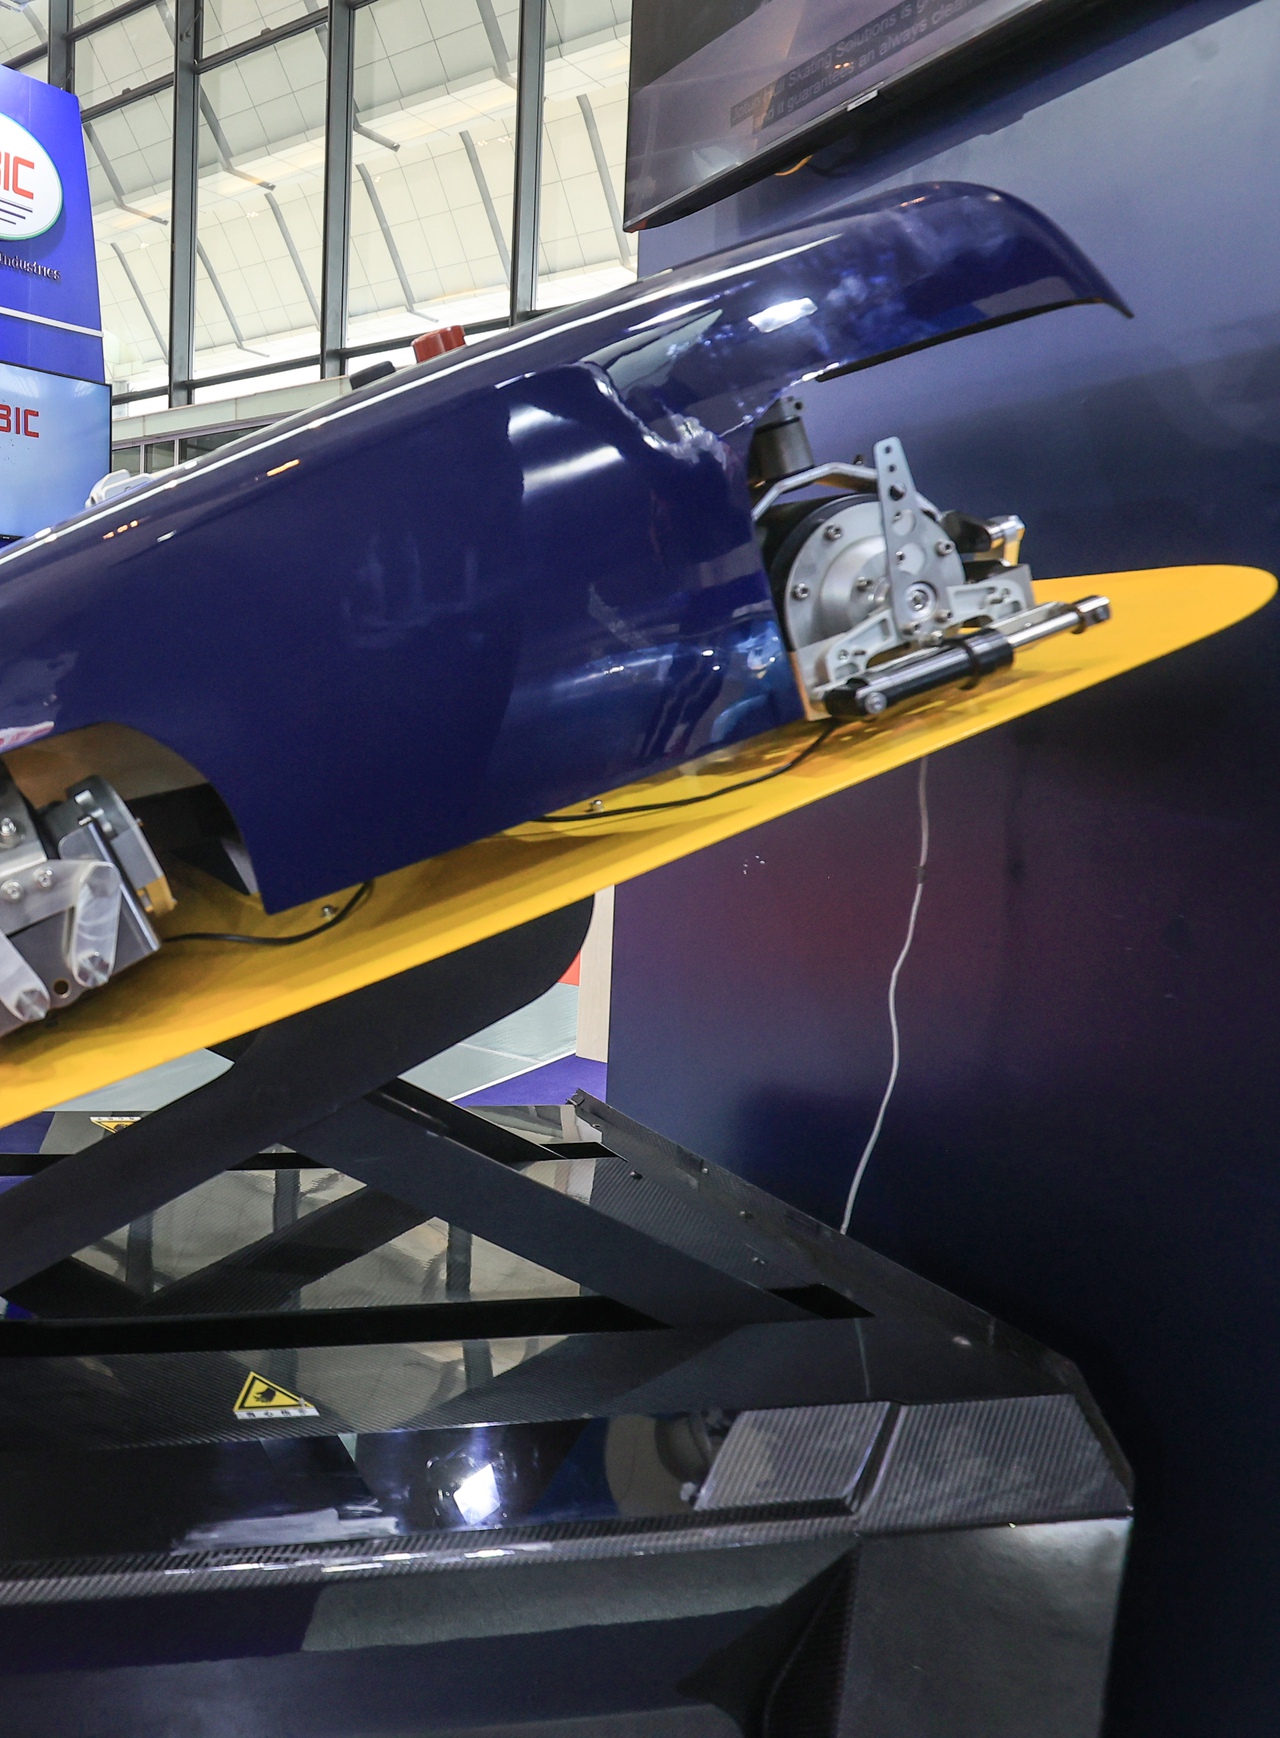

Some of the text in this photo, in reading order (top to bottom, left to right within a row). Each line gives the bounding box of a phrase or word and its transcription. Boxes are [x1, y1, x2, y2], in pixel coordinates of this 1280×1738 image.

[787, 66, 854, 111] guarantees
[859, 50, 875, 67] an
[880, 19, 927, 55] always
[789, 53, 833, 86] Skating
[837, 14, 896, 57] Solutions
